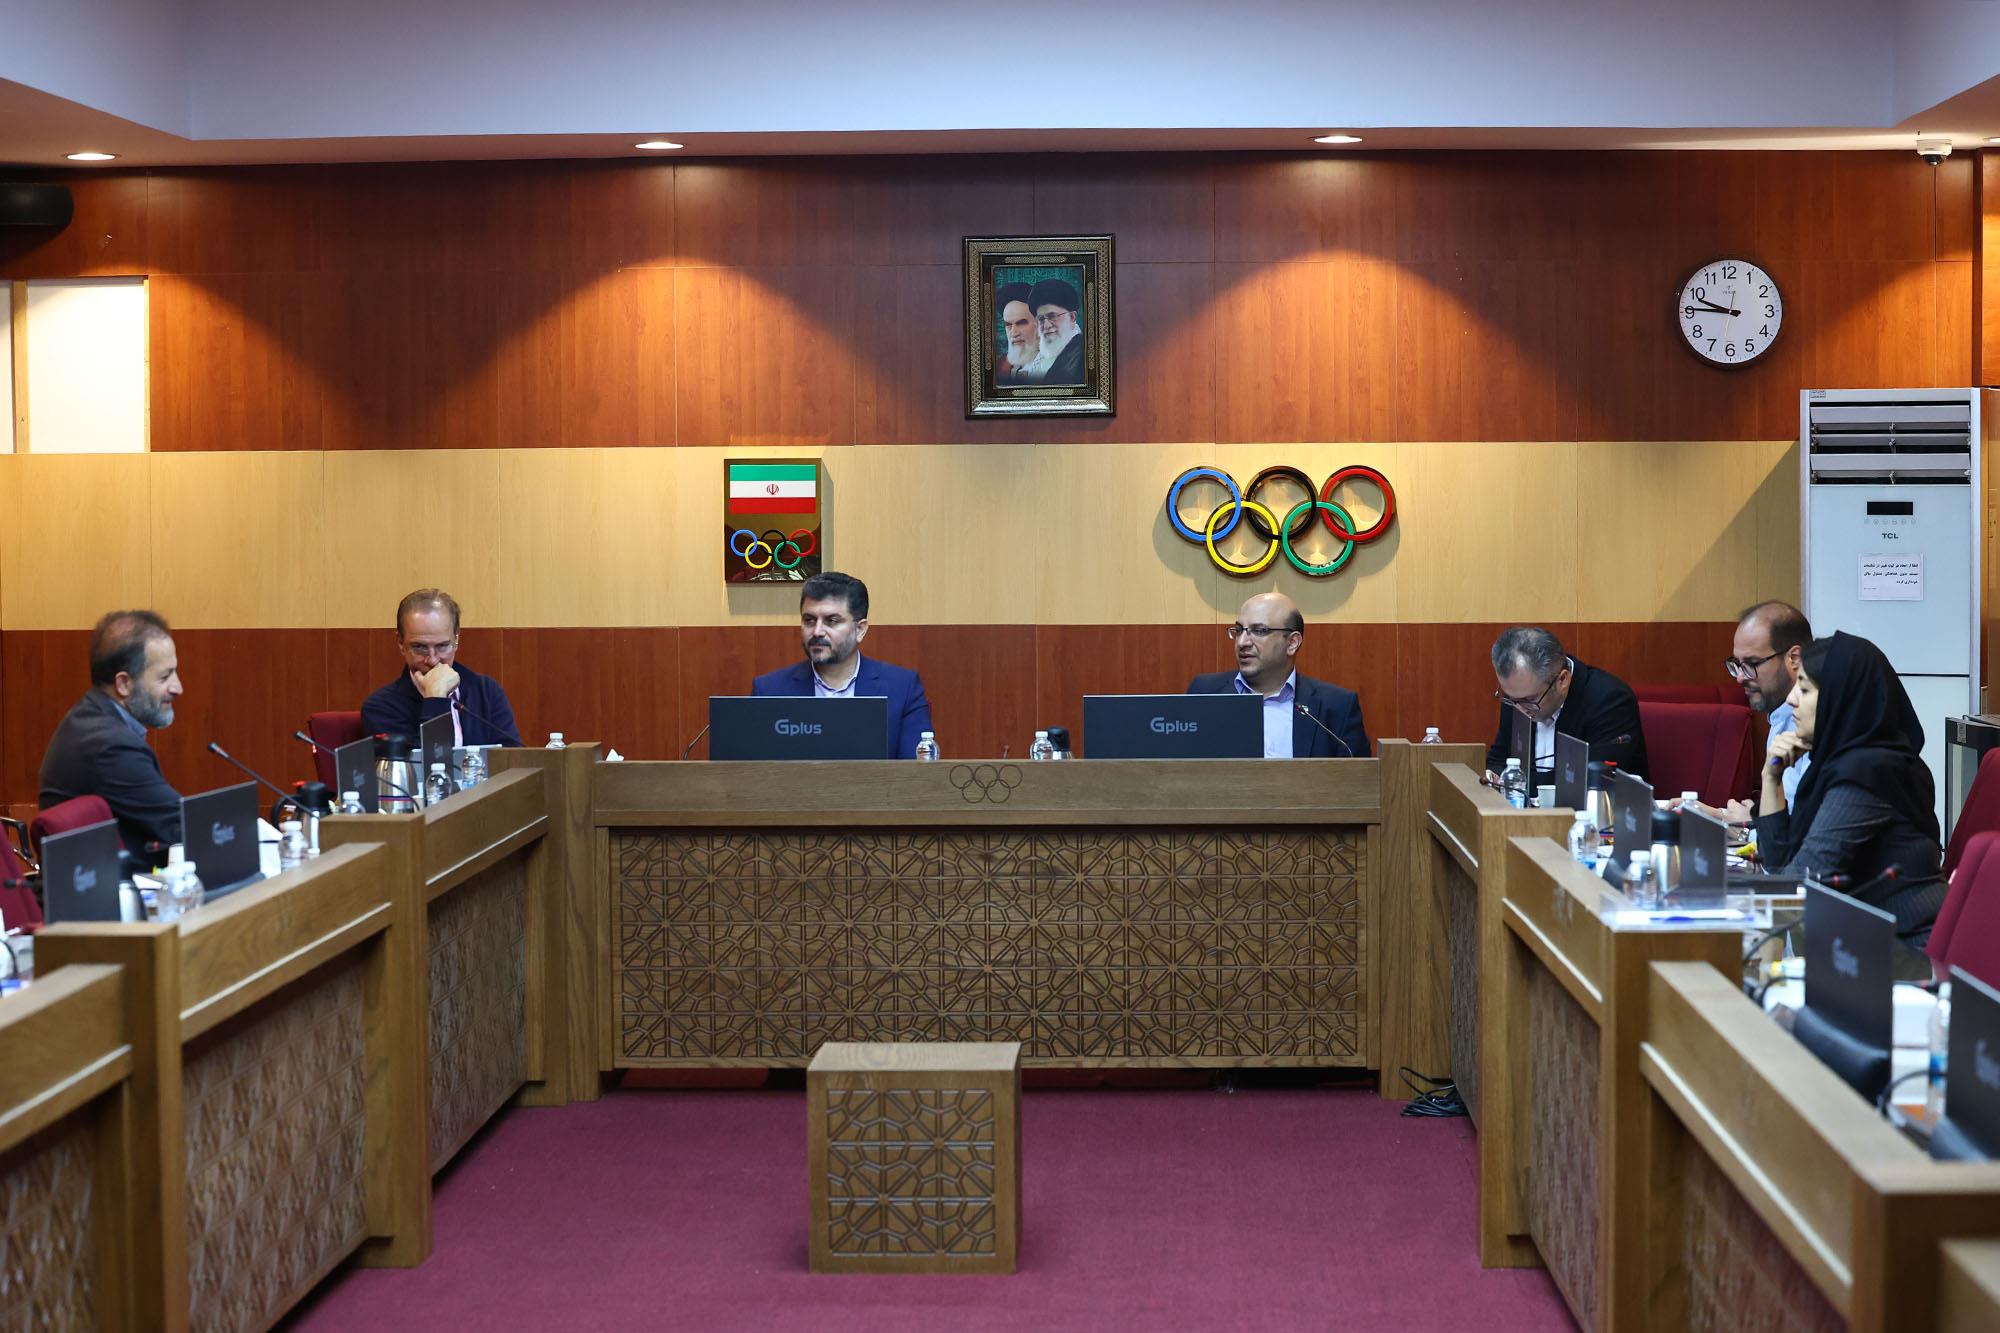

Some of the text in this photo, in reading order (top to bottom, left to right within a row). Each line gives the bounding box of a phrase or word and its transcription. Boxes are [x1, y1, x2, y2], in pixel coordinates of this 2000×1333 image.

[1704, 272, 1716, 285] 11
[1722, 266, 1737, 280] 12
[1746, 271, 1751, 285] 1
[1689, 287, 1705, 300] 10
[1759, 285, 1769, 298] 2
[1684, 305, 1695, 319] 9
[1764, 304, 1775, 318] 3
[1692, 325, 1703, 338] 8
[1759, 324, 1769, 338] 4
[1706, 339, 1717, 352] 7
[1725, 343, 1736, 357] 6
[1745, 339, 1755, 352] 5
[774, 719, 822, 737] Gplus
[1150, 716, 1198, 735] Gplus
